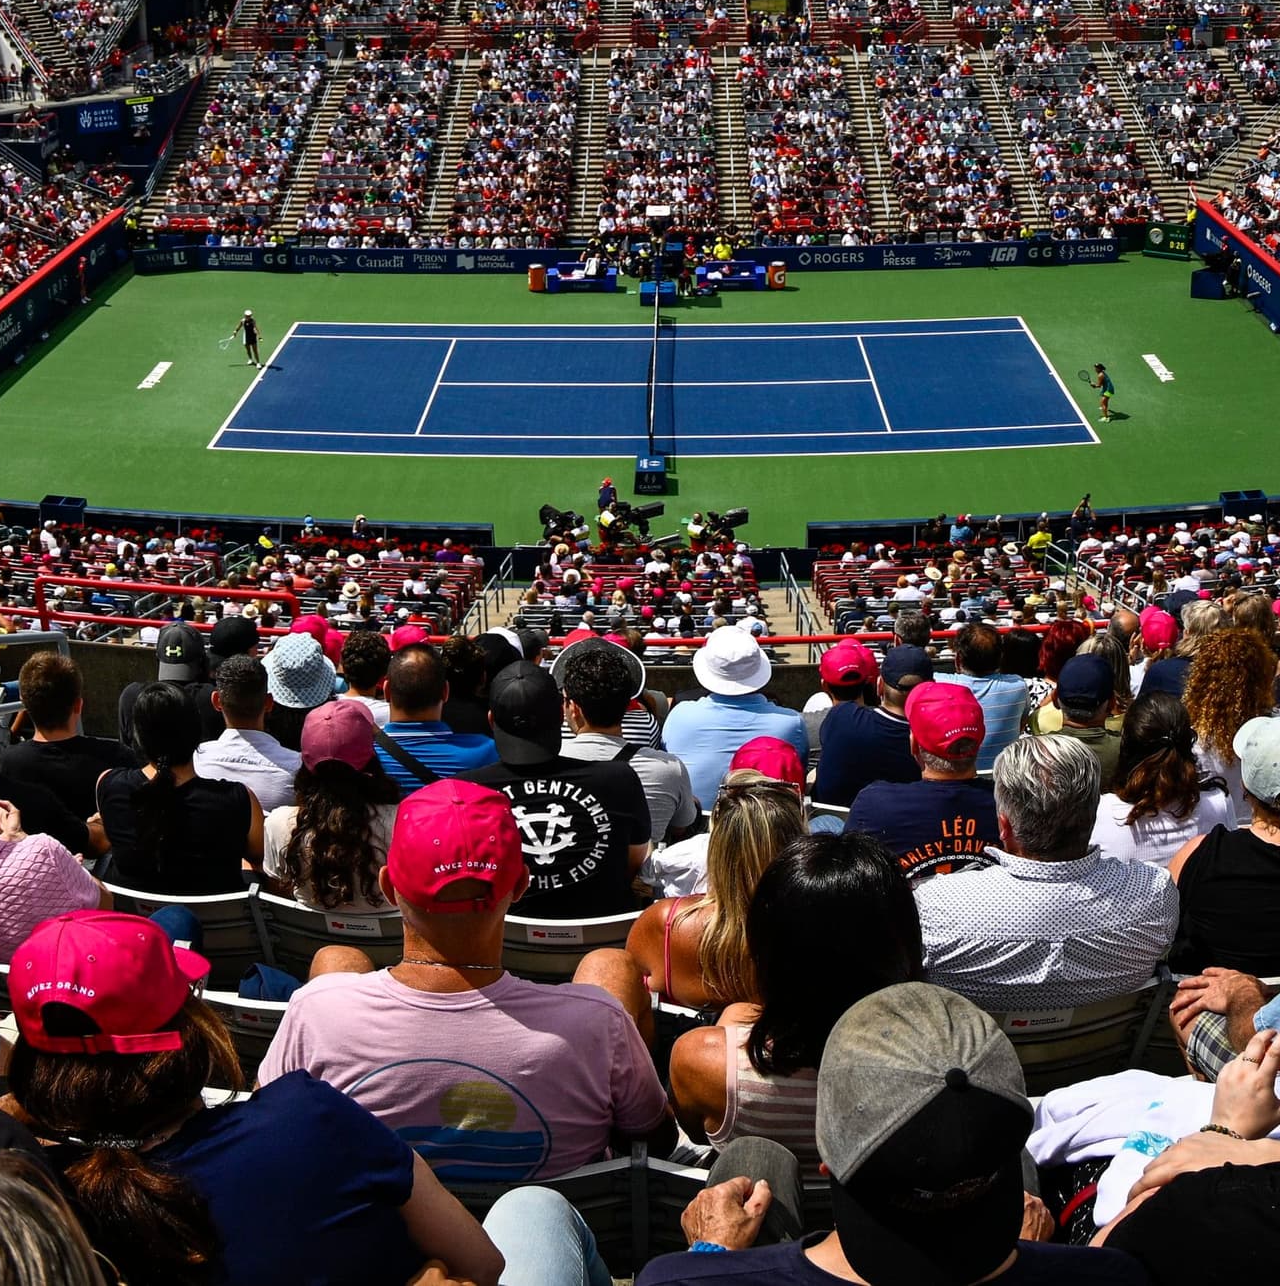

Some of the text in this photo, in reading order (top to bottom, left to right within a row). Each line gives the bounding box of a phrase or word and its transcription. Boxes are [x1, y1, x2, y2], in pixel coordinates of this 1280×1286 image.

[132, 104, 149, 114] 135
[1077, 244, 1114, 253] CASINO
[1170, 240, 1185, 251] 0:26
[220, 251, 253, 261] Natural
[413, 254, 447, 263] PERONI
[814, 252, 865, 264] ROGERS
[990, 247, 1017, 262] IGA
[357, 255, 404, 268] Canada
[883, 257, 916, 266] PRESSE
[774, 271, 785, 283] G
[1252, 269, 1272, 294] ROGERS
[524, 780, 611, 833] GENTLEMEN
[942, 815, 976, 837] LÉO
[569, 841, 609, 882] FIGHT
[57, 981, 95, 998] GRAND
